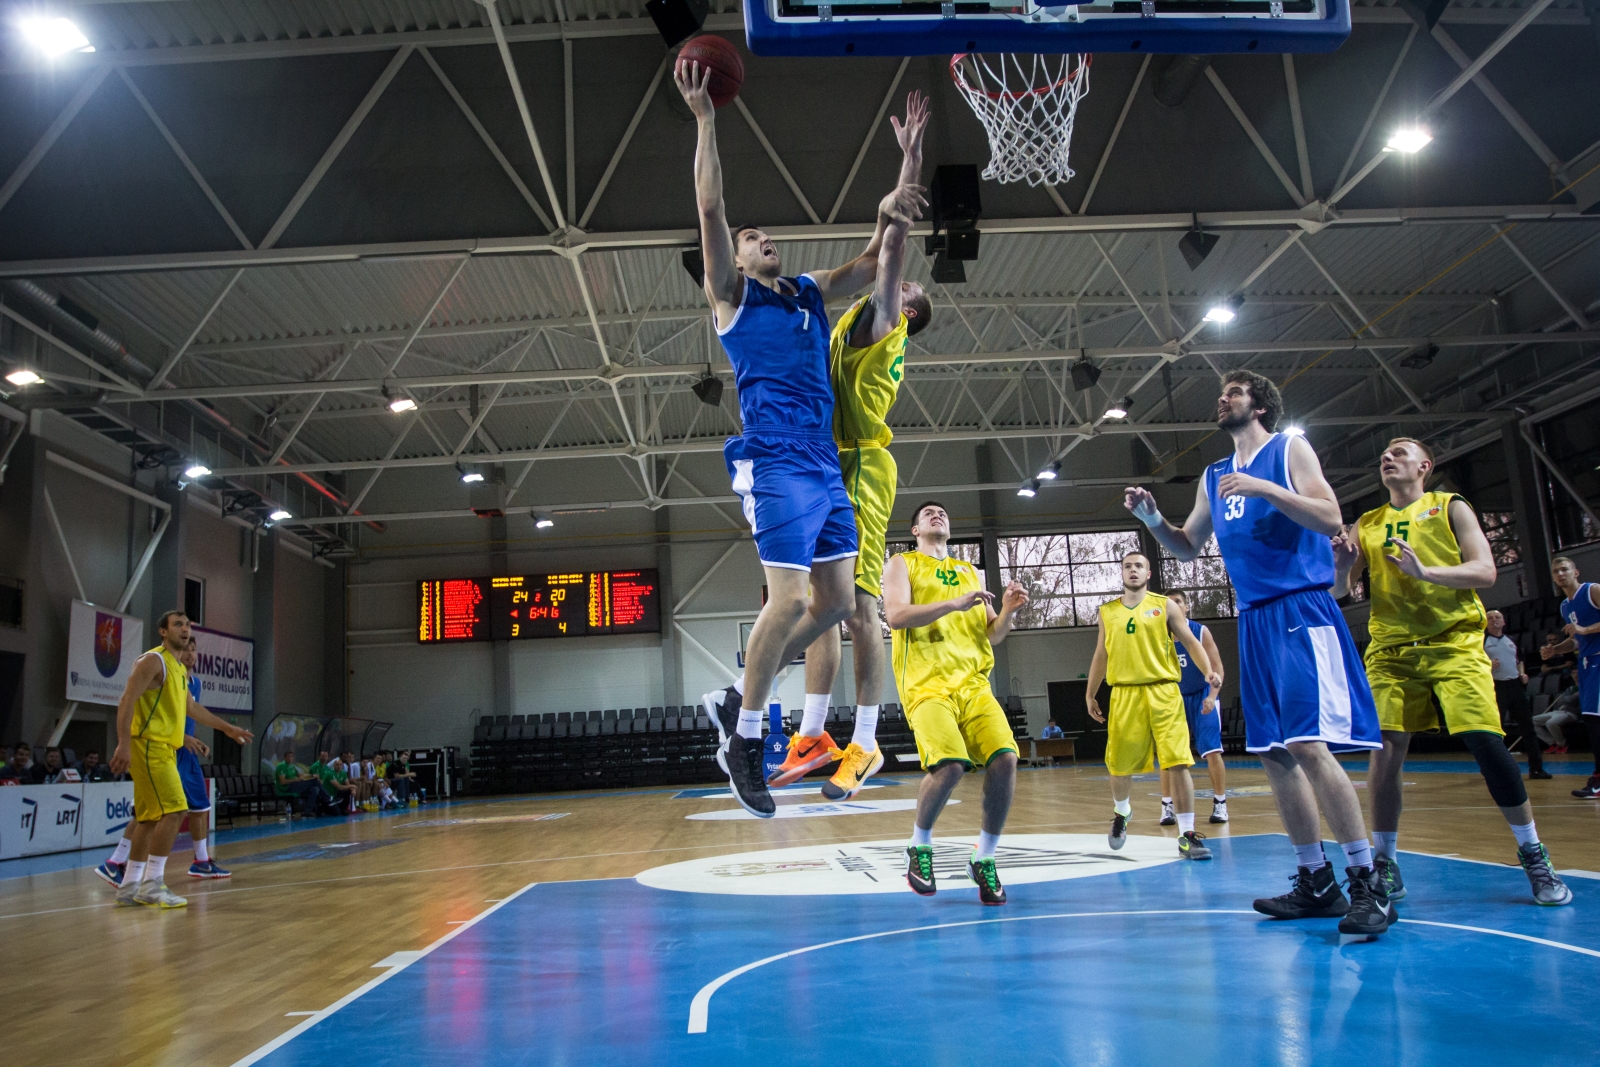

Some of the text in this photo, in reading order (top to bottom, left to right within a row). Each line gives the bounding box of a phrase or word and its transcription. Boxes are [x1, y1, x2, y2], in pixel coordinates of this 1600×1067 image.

[797, 305, 809, 331] 7
[1225, 495, 1246, 521] 33
[1383, 521, 1410, 547] 15
[936, 569, 960, 587] 42
[513, 589, 566, 603] 24 2 20
[512, 622, 567, 636] 3 4
[1126, 617, 1136, 635] 6
[1177, 653, 1188, 668] 5
[202, 680, 215, 691] GOS
[106, 797, 131, 820] bek
[56, 810, 77, 826] LRT
